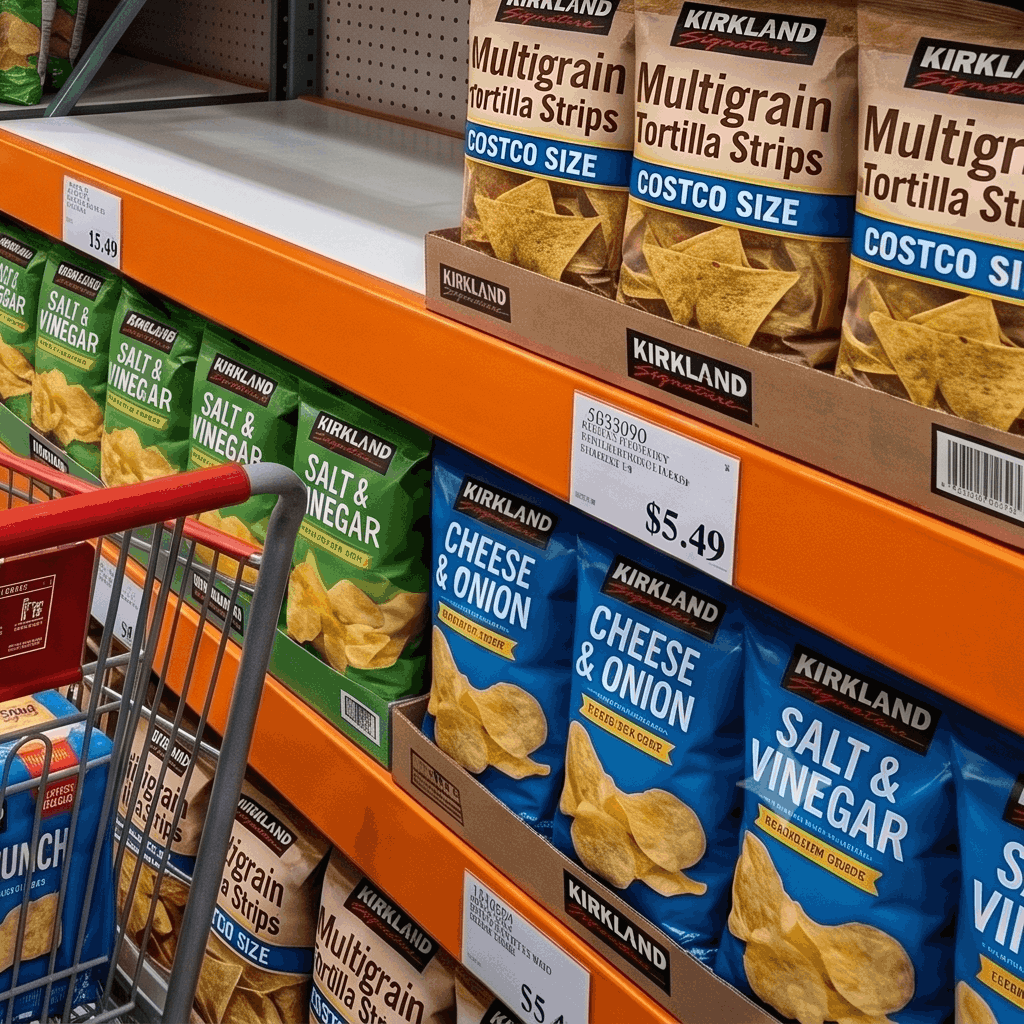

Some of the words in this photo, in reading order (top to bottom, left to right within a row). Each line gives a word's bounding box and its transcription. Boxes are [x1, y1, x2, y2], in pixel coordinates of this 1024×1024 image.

[684, 9, 817, 43] KIRKLAND
[472, 35, 627, 95] Multigrain
[539, 93, 619, 137] Strips
[636, 61, 832, 133] Multigrain
[467, 129, 538, 166] COSTCO
[544, 146, 598, 178] SIZE
[636, 111, 722, 159] Tortilla
[729, 130, 824, 180] Strips
[637, 169, 727, 213] COSTCO
[735, 190, 800, 227] SIZE
[863, 161, 970, 218] Tortilla
[89, 229, 118, 258] 15.49
[864, 226, 977, 280] COSTCO
[47, 290, 80, 321] SALT
[80, 306, 90, 327] &
[443, 268, 507, 307] KIRKLAND
[39, 308, 99, 354] VINEGAR
[108, 361, 173, 413] VINEGAR
[117, 342, 152, 374] SALT
[151, 358, 163, 382] &
[634, 337, 748, 398] KIRKLAND
[192, 414, 263, 465] VINEGAR
[201, 391, 243, 430] SALT
[241, 411, 255, 440] &
[317, 415, 393, 460] KIRKLAND
[305, 453, 355, 499] SALT
[353, 477, 369, 509] &
[463, 481, 553, 532] KIRKLAND
[306, 485, 381, 549] INEGAR
[645, 501, 725, 562] $5.49
[444, 521, 536, 589] CHEESE
[436, 553, 448, 591] &
[453, 565, 532, 631] ONION
[612, 562, 719, 623] KIRKLAND
[589, 605, 701, 687] CHEESE
[575, 641, 594, 682] &
[601, 656, 696, 733] ONION
[794, 653, 932, 731] KIRKLAND
[776, 706, 871, 782] SALT
[869, 756, 900, 804] &
[752, 737, 909, 863] VINEGAR
[231, 888, 281, 937] Strips
[357, 885, 433, 954] KIRKLAND
[568, 878, 667, 971] KIRKLAND
[237, 931, 271, 966] SIZE
[316, 905, 425, 1024] Multigrain
